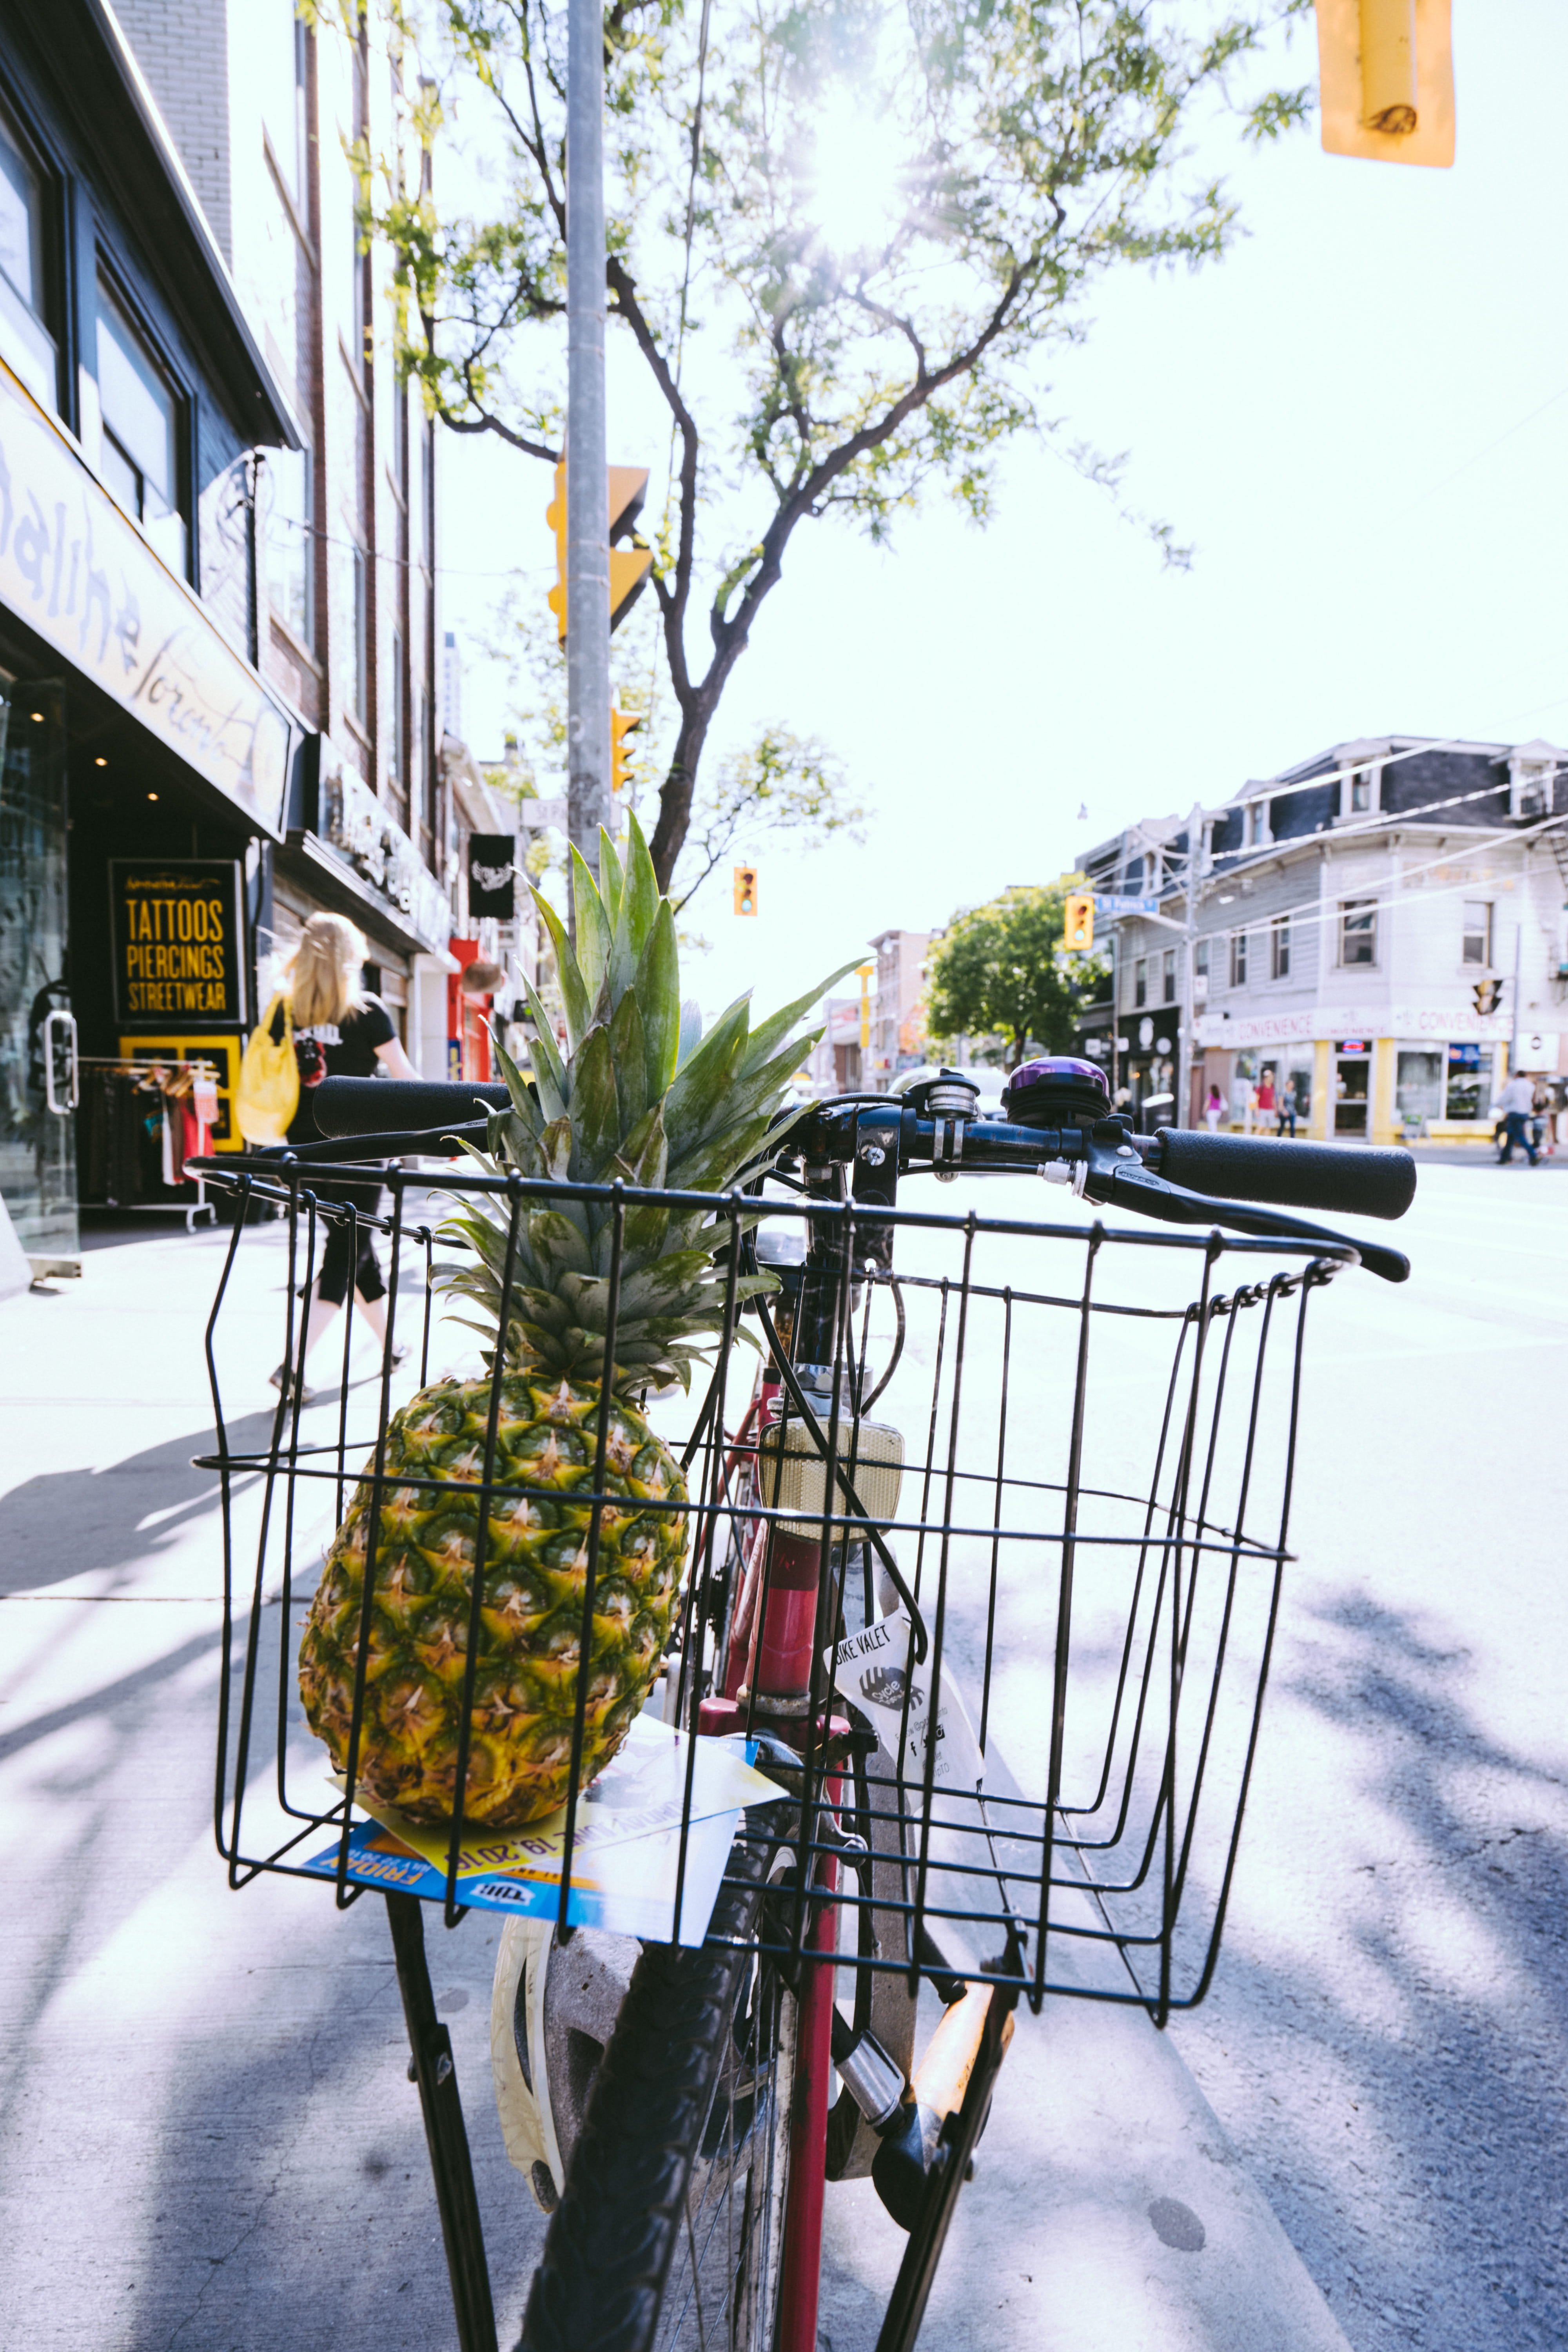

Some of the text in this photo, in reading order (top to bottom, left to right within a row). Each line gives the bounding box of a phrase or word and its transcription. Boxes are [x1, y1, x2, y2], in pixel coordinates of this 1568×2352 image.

[125, 899, 223, 942] TATTOOS
[127, 945, 225, 979] PIERCINGS
[128, 982, 227, 1011] STREETWEAR
[1240, 1014, 1312, 1040] CONVENIENCE
[857, 1624, 890, 1655] VALET
[872, 1681, 900, 1700] Cycle
